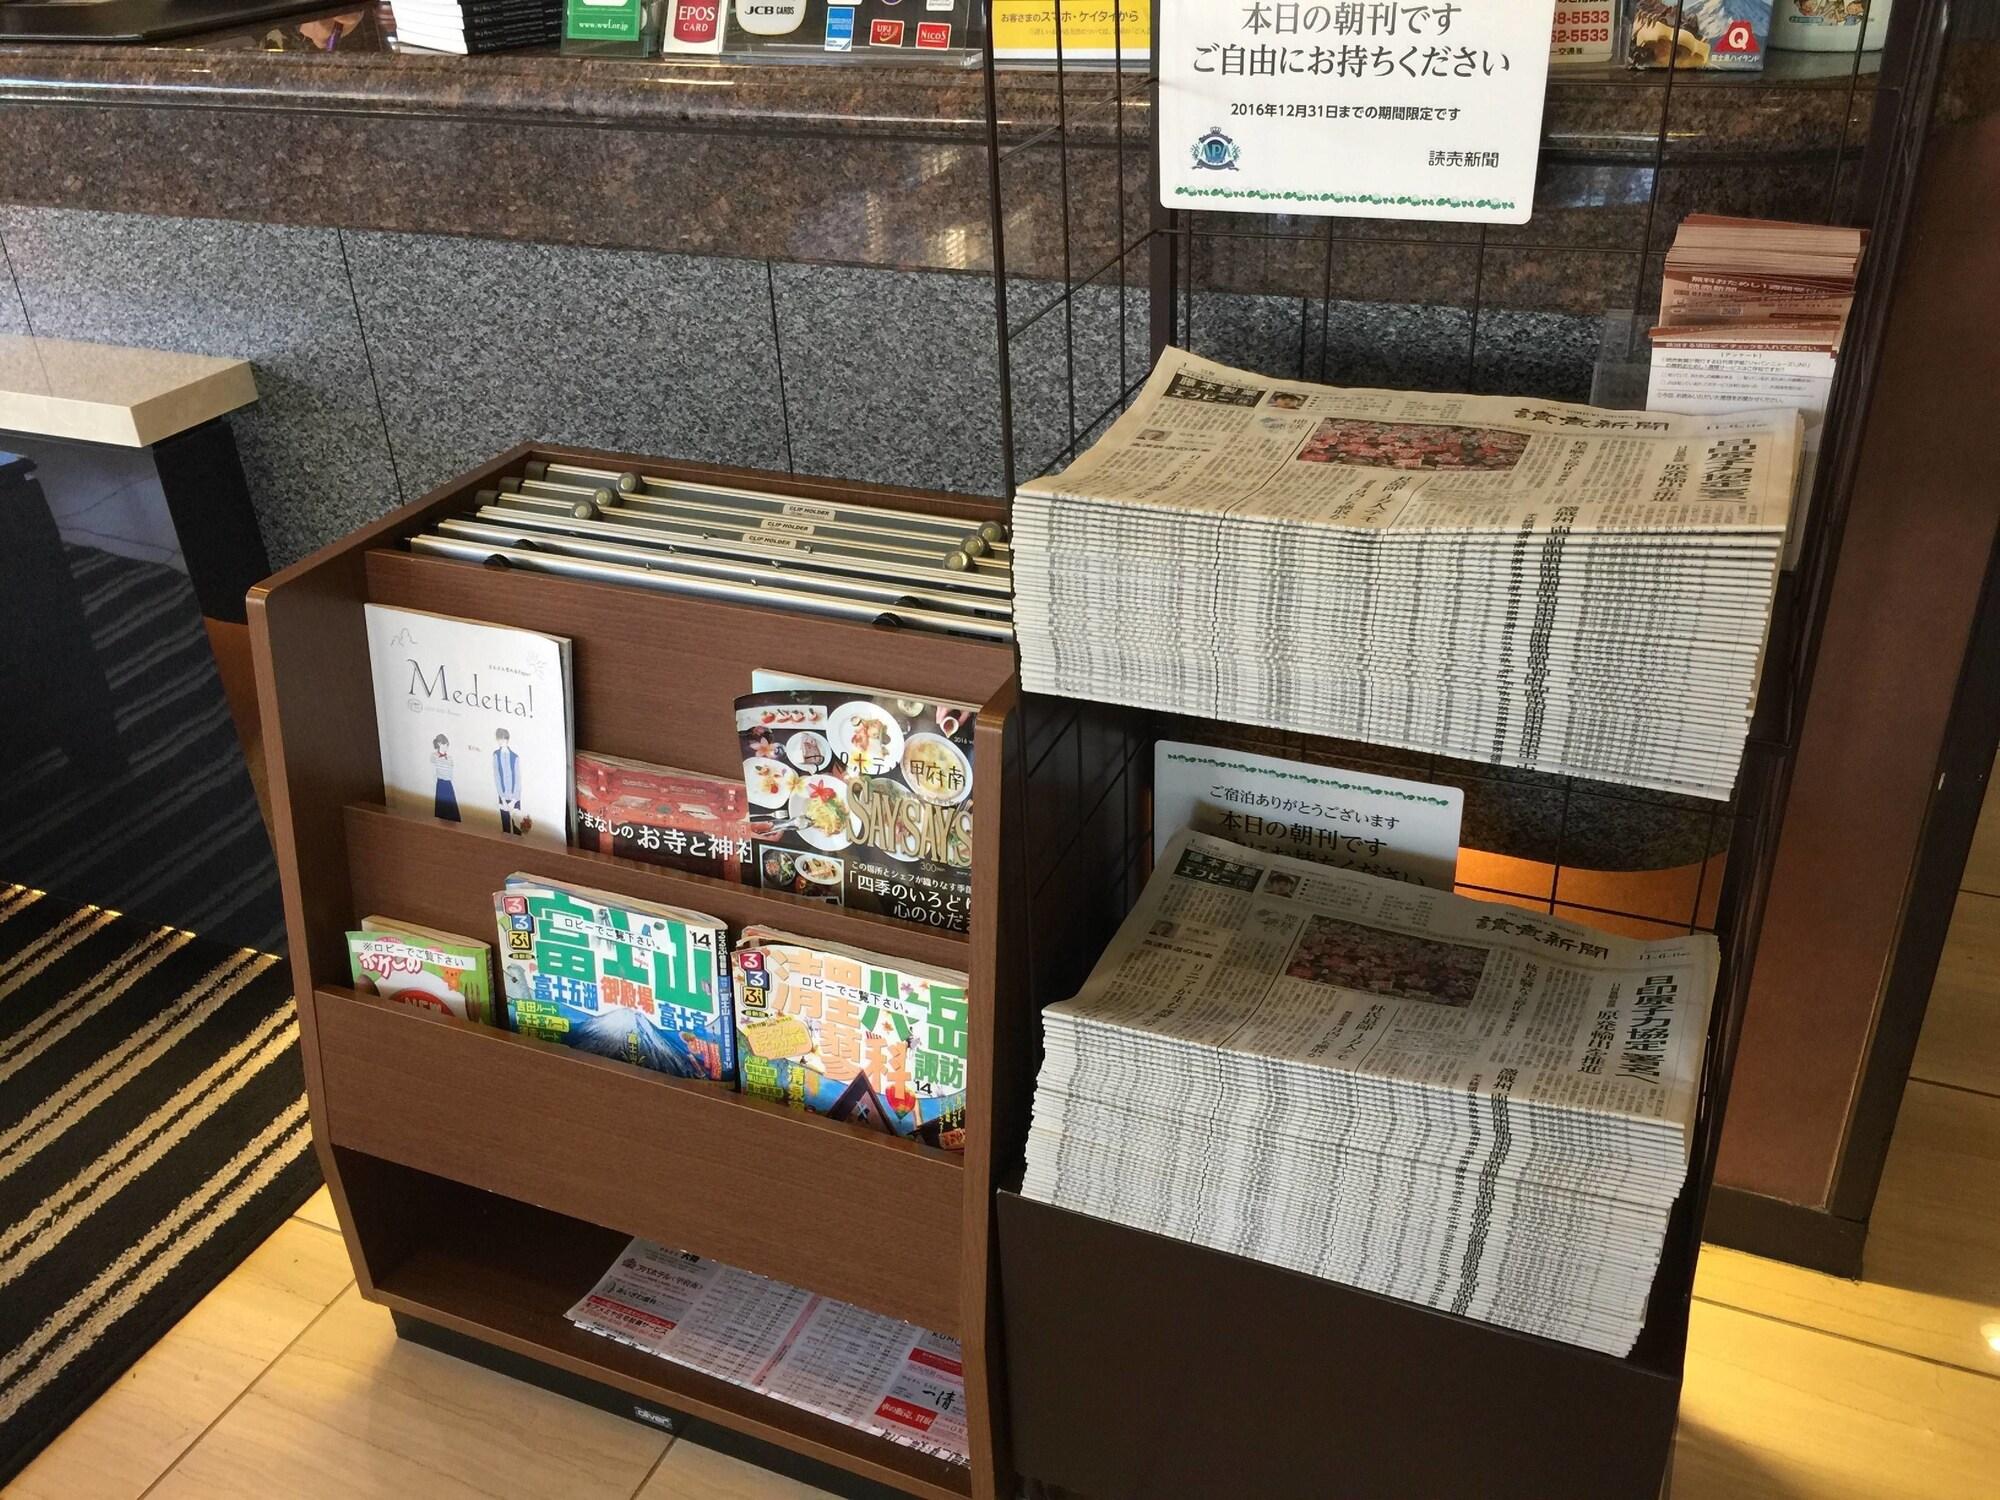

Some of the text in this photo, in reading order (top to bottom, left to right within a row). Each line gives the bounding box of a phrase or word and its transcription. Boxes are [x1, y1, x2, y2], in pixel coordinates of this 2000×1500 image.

[679, 6, 716, 21] EPOS
[744, 6, 795, 15] JCB CARDS
[1241, 2, 1463, 36] 本日の朝刊です
[683, 23, 708, 32] CARD
[921, 29, 946, 40] NICOS
[1729, 28, 1749, 49] Q
[1193, 43, 1511, 78] ご自由にお持ちください
[1230, 103, 1462, 122] 2016年12月31日までの期間限定です
[1428, 149, 1500, 169] 読売新聞
[783, 523, 809, 531] HOLDER
[804, 507, 829, 516] HOLDER
[407, 658, 534, 719] Medetta!
[910, 760, 966, 790] 甲府南
[1210, 784, 1400, 830] ご宿泊ありがとうございます
[1219, 810, 1387, 857] 本日の朝刊です
[893, 901, 971, 932] 心のひだ
[564, 918, 661, 950] ロビーでご覧下さい。
[516, 1000, 557, 1014] 吉田ルート
[533, 973, 599, 1011] 富士五湖
[601, 976, 655, 1015] 御殿場
[802, 978, 910, 1014] ロビーでご覧下さい。
[658, 1002, 708, 1034] 富士宮
[914, 1050, 964, 1088] 諏訪
